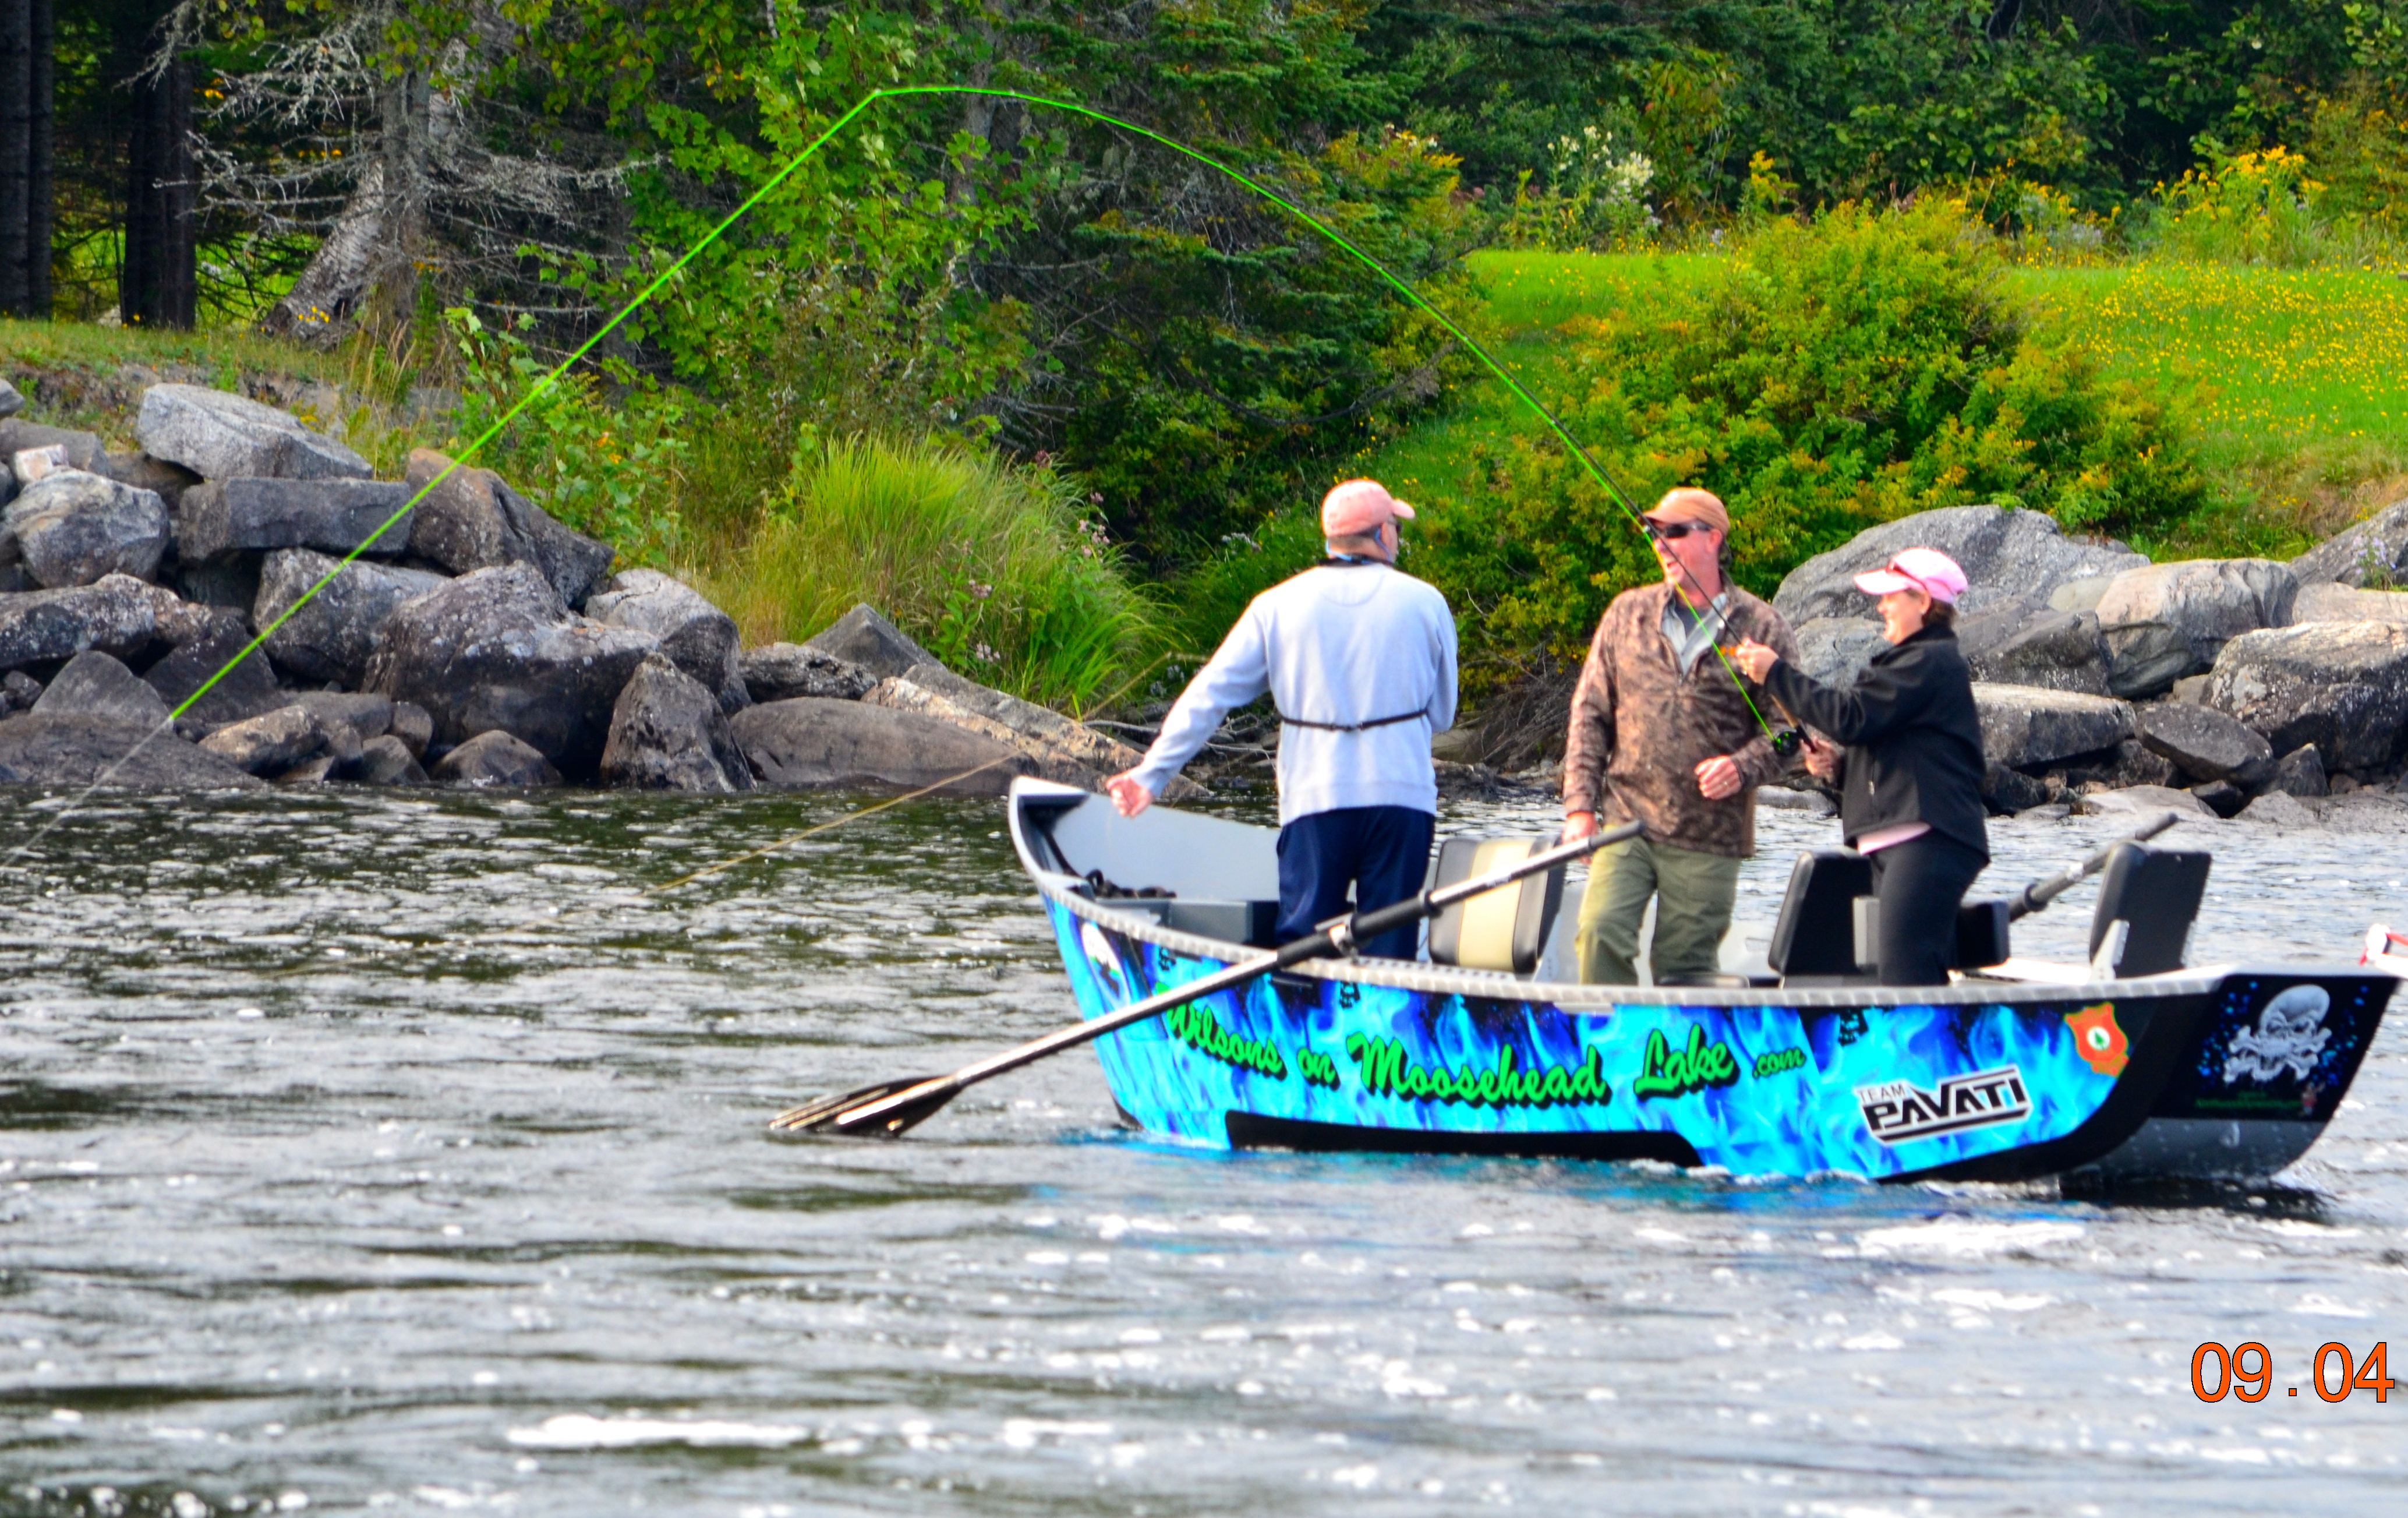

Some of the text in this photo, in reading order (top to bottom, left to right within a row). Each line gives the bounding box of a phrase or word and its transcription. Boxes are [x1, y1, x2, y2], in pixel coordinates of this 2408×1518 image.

[1296, 1047, 1341, 1091] on
[1345, 1030, 1612, 1108] Moosehead
[1633, 1023, 1740, 1101] Lake
[1752, 1047, 1806, 1079] .com
[1858, 1082, 1906, 1103] TEAM
[1864, 1074, 2027, 1132] PAVATI
